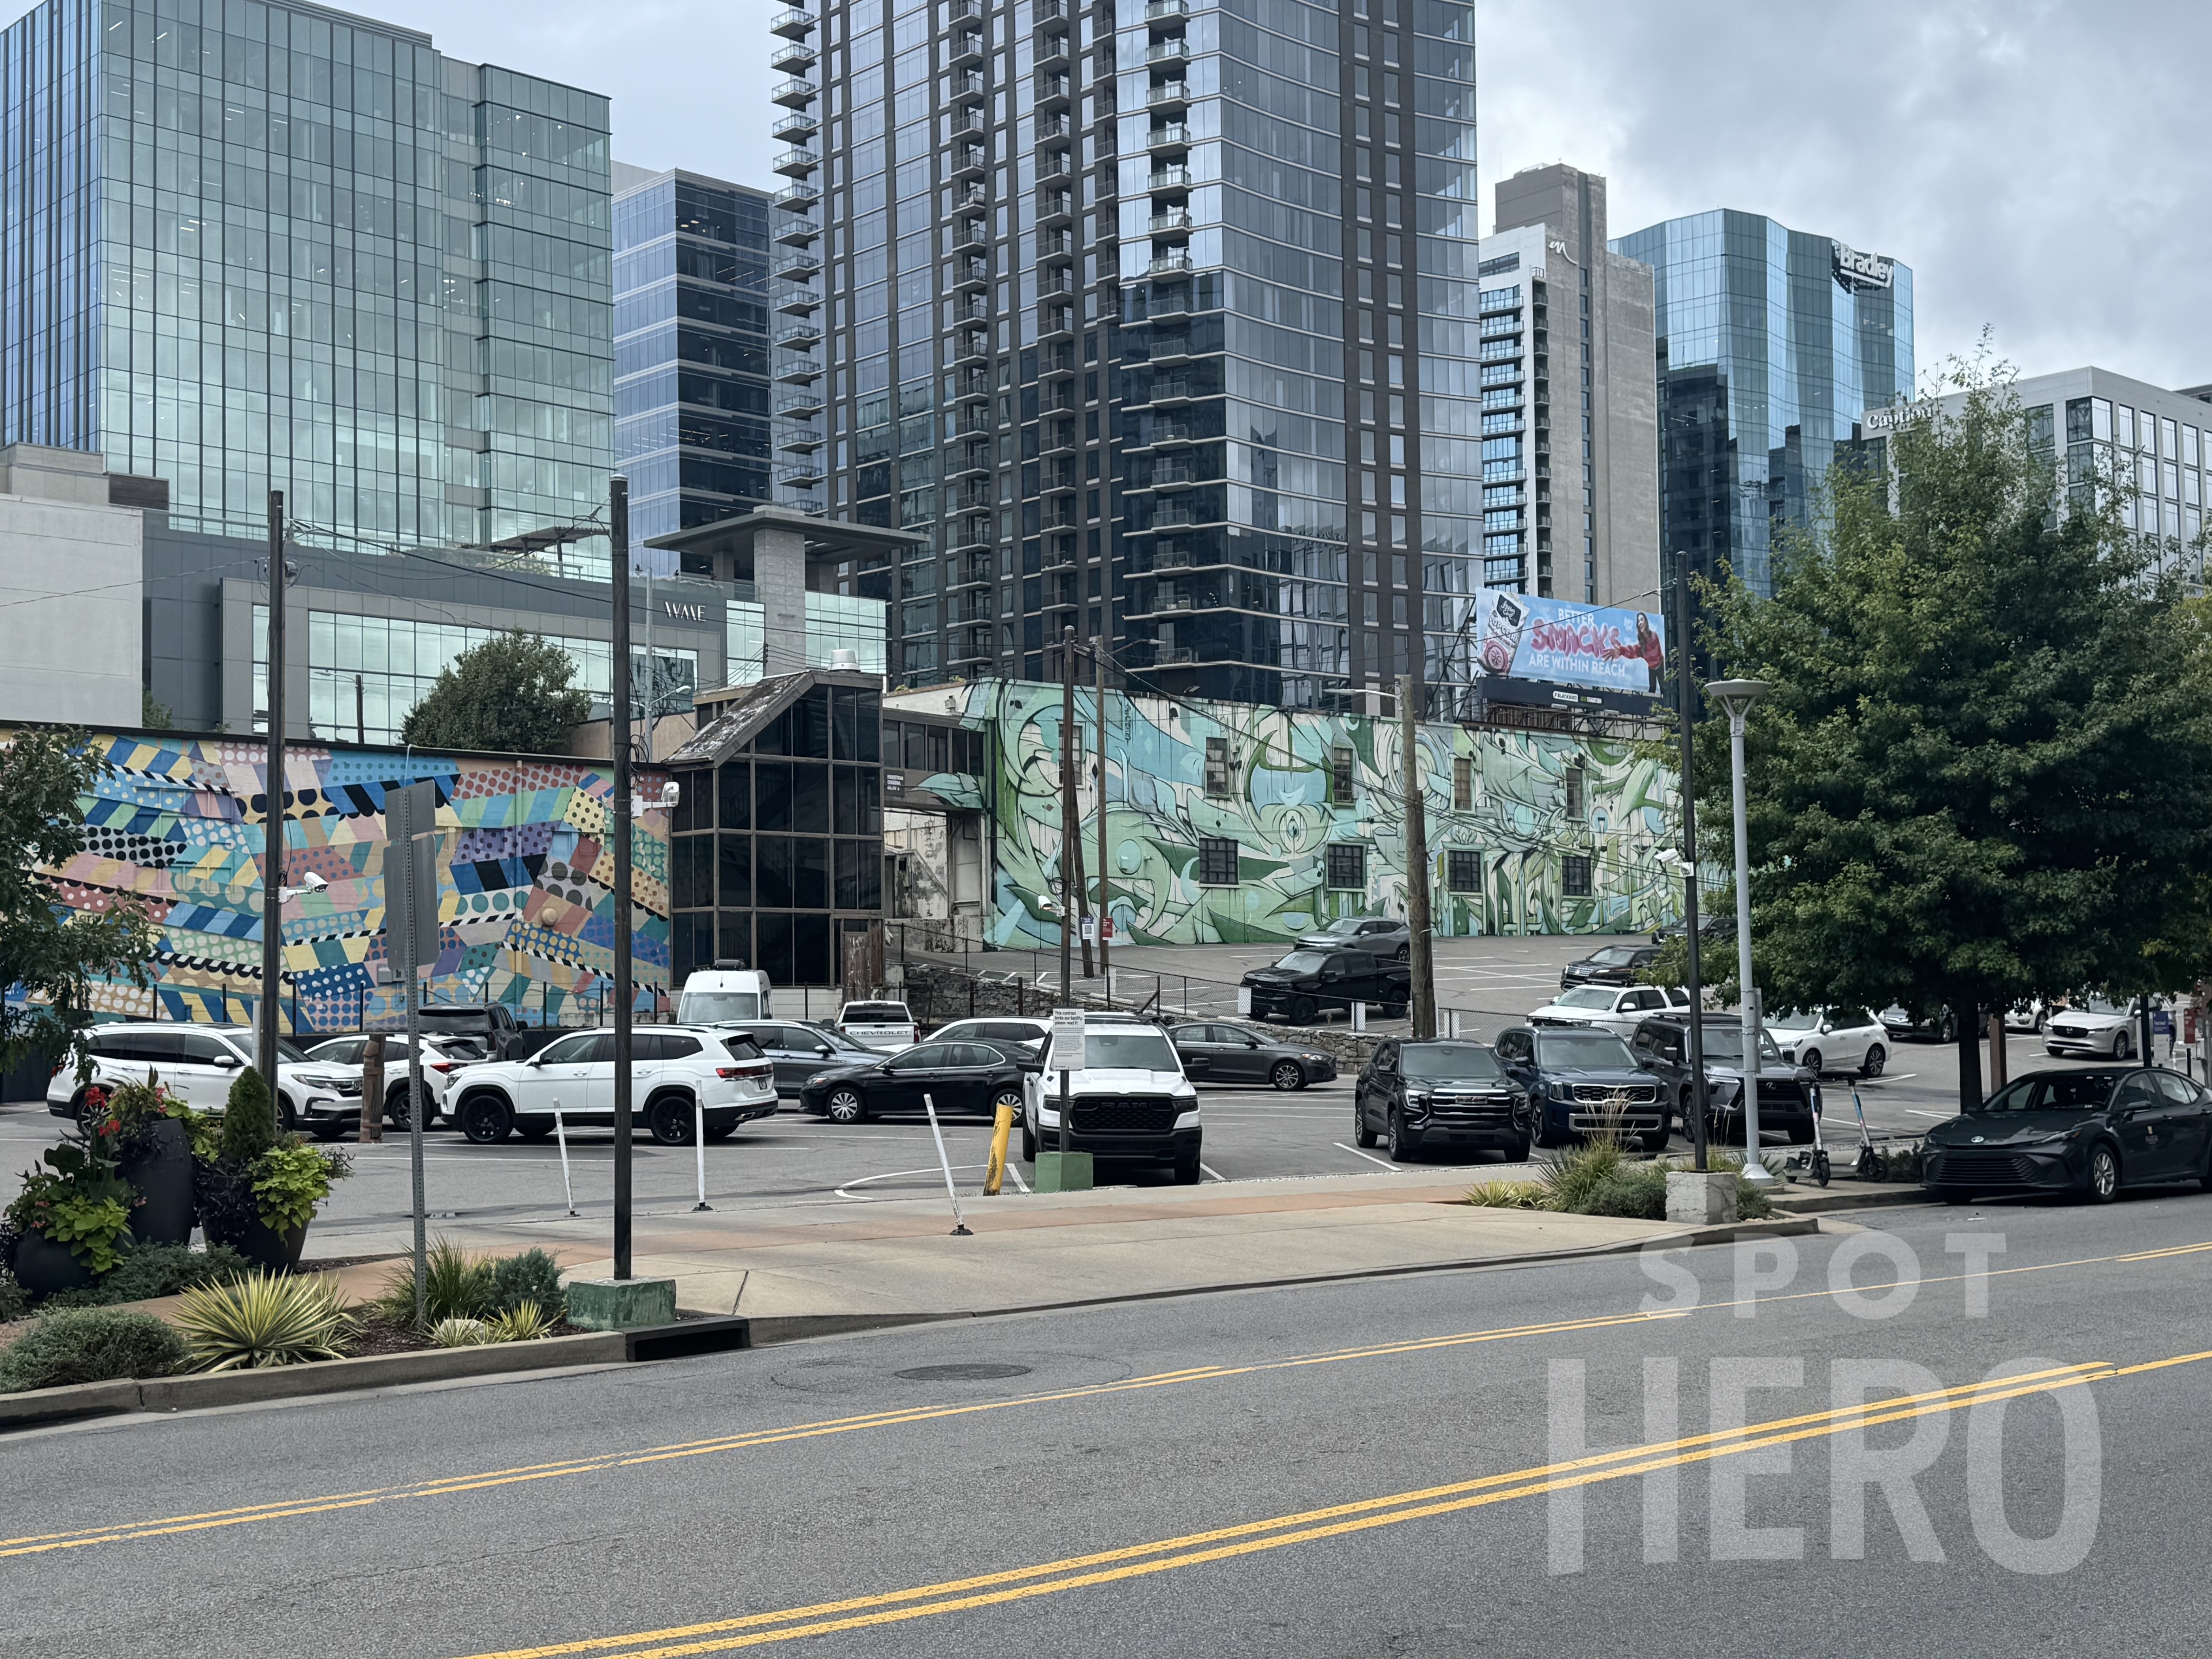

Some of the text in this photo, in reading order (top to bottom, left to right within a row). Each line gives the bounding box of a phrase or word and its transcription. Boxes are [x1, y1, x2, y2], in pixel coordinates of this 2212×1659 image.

[1840, 243, 1894, 288] Bradley
[1866, 406, 1933, 430] Caption
[1558, 608, 1594, 625] BETTER
[1531, 617, 1622, 661] SNACKS
[1528, 653, 1626, 677] ARE WITHIN REACH
